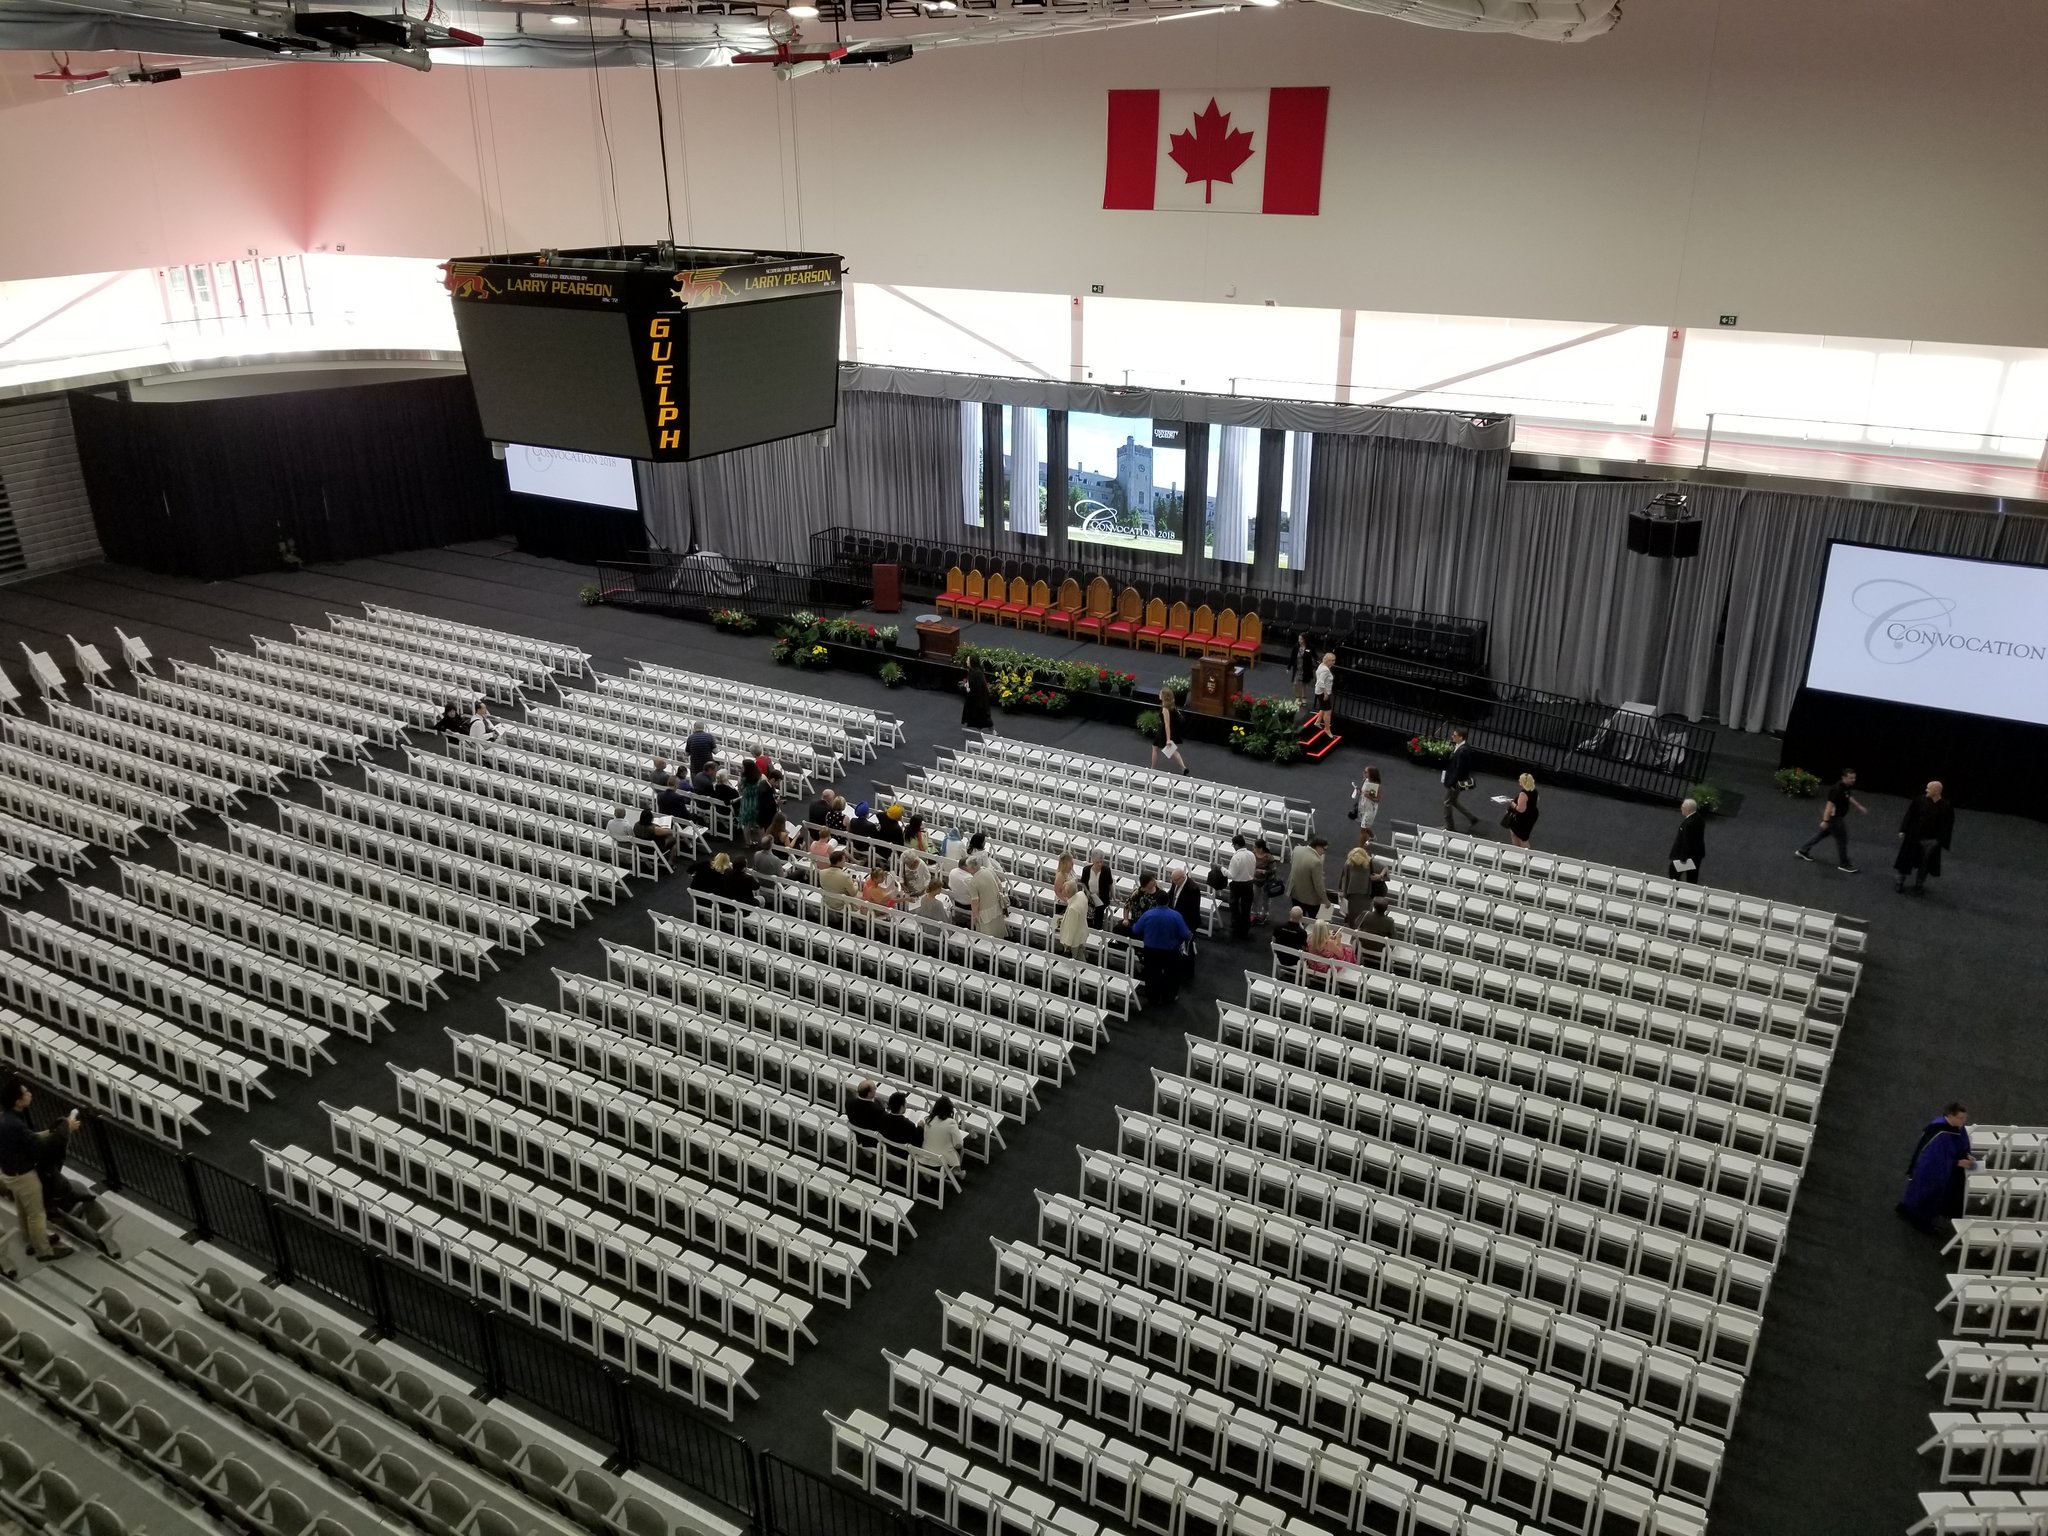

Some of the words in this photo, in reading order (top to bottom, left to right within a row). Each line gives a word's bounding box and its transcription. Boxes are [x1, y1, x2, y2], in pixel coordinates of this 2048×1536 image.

[507, 278, 549, 293] LARRY
[551, 280, 613, 297] PEARSON
[744, 273, 781, 290] LARRY
[783, 268, 832, 286] PEARSON
[649, 318, 681, 449] GUELPH
[532, 447, 598, 465] CONVOCATION
[1090, 520, 1156, 537] CONVOCATION
[1158, 530, 1176, 540] 2018
[1886, 622, 2046, 660] CONVOCATION
